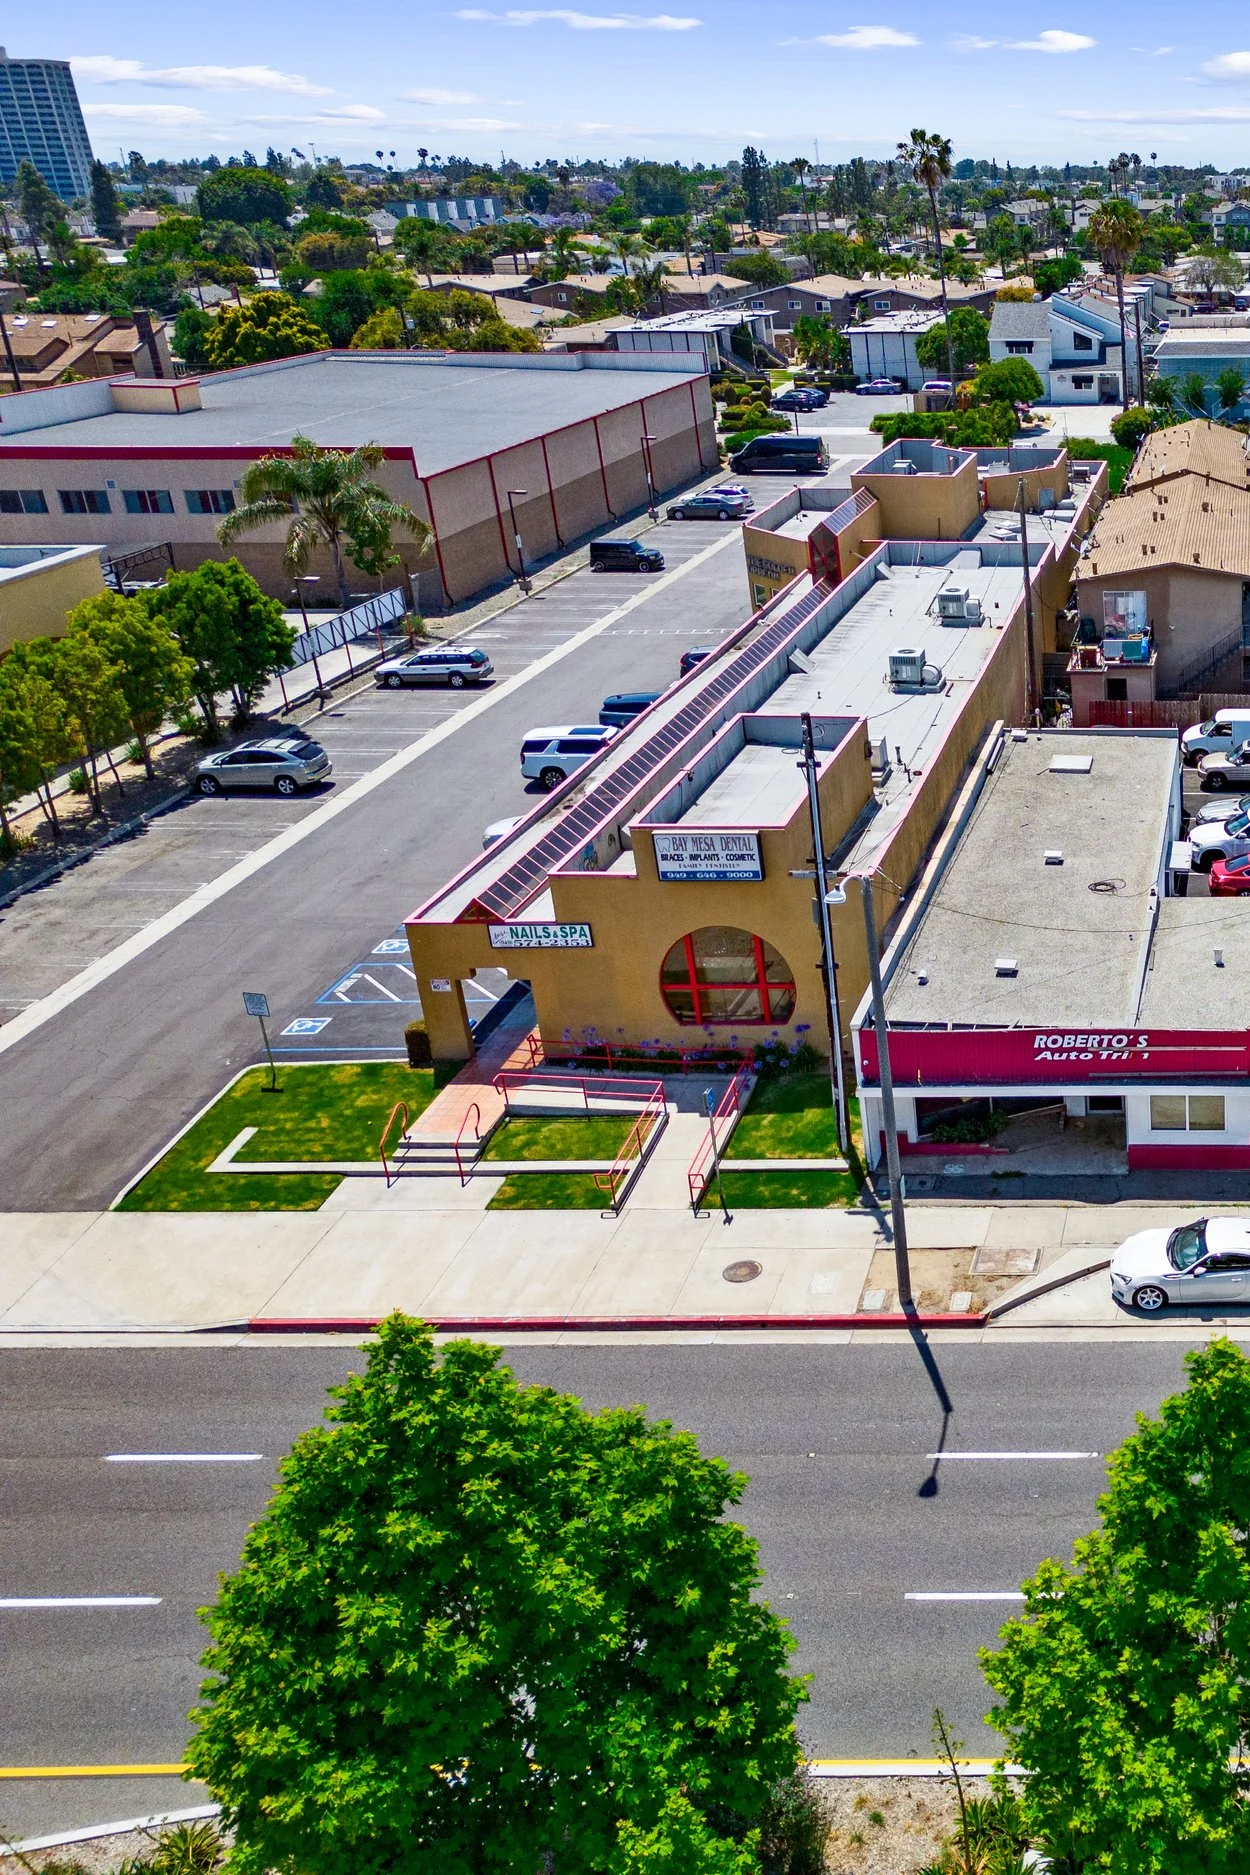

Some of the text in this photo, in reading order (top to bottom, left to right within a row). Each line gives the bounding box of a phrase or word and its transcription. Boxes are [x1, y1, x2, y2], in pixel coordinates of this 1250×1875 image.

[672, 836, 754, 852] BAY MESA DENTAL
[660, 853, 756, 862] BRACES IMPLANTS COSMETIC
[666, 871, 687, 879] 949
[696, 871, 717, 879] 646
[509, 926, 551, 939] NAILS
[560, 926, 588, 939] SPA
[1033, 1035, 1149, 1048] ROBERTO'S
[1034, 1051, 1094, 1060] Auto
